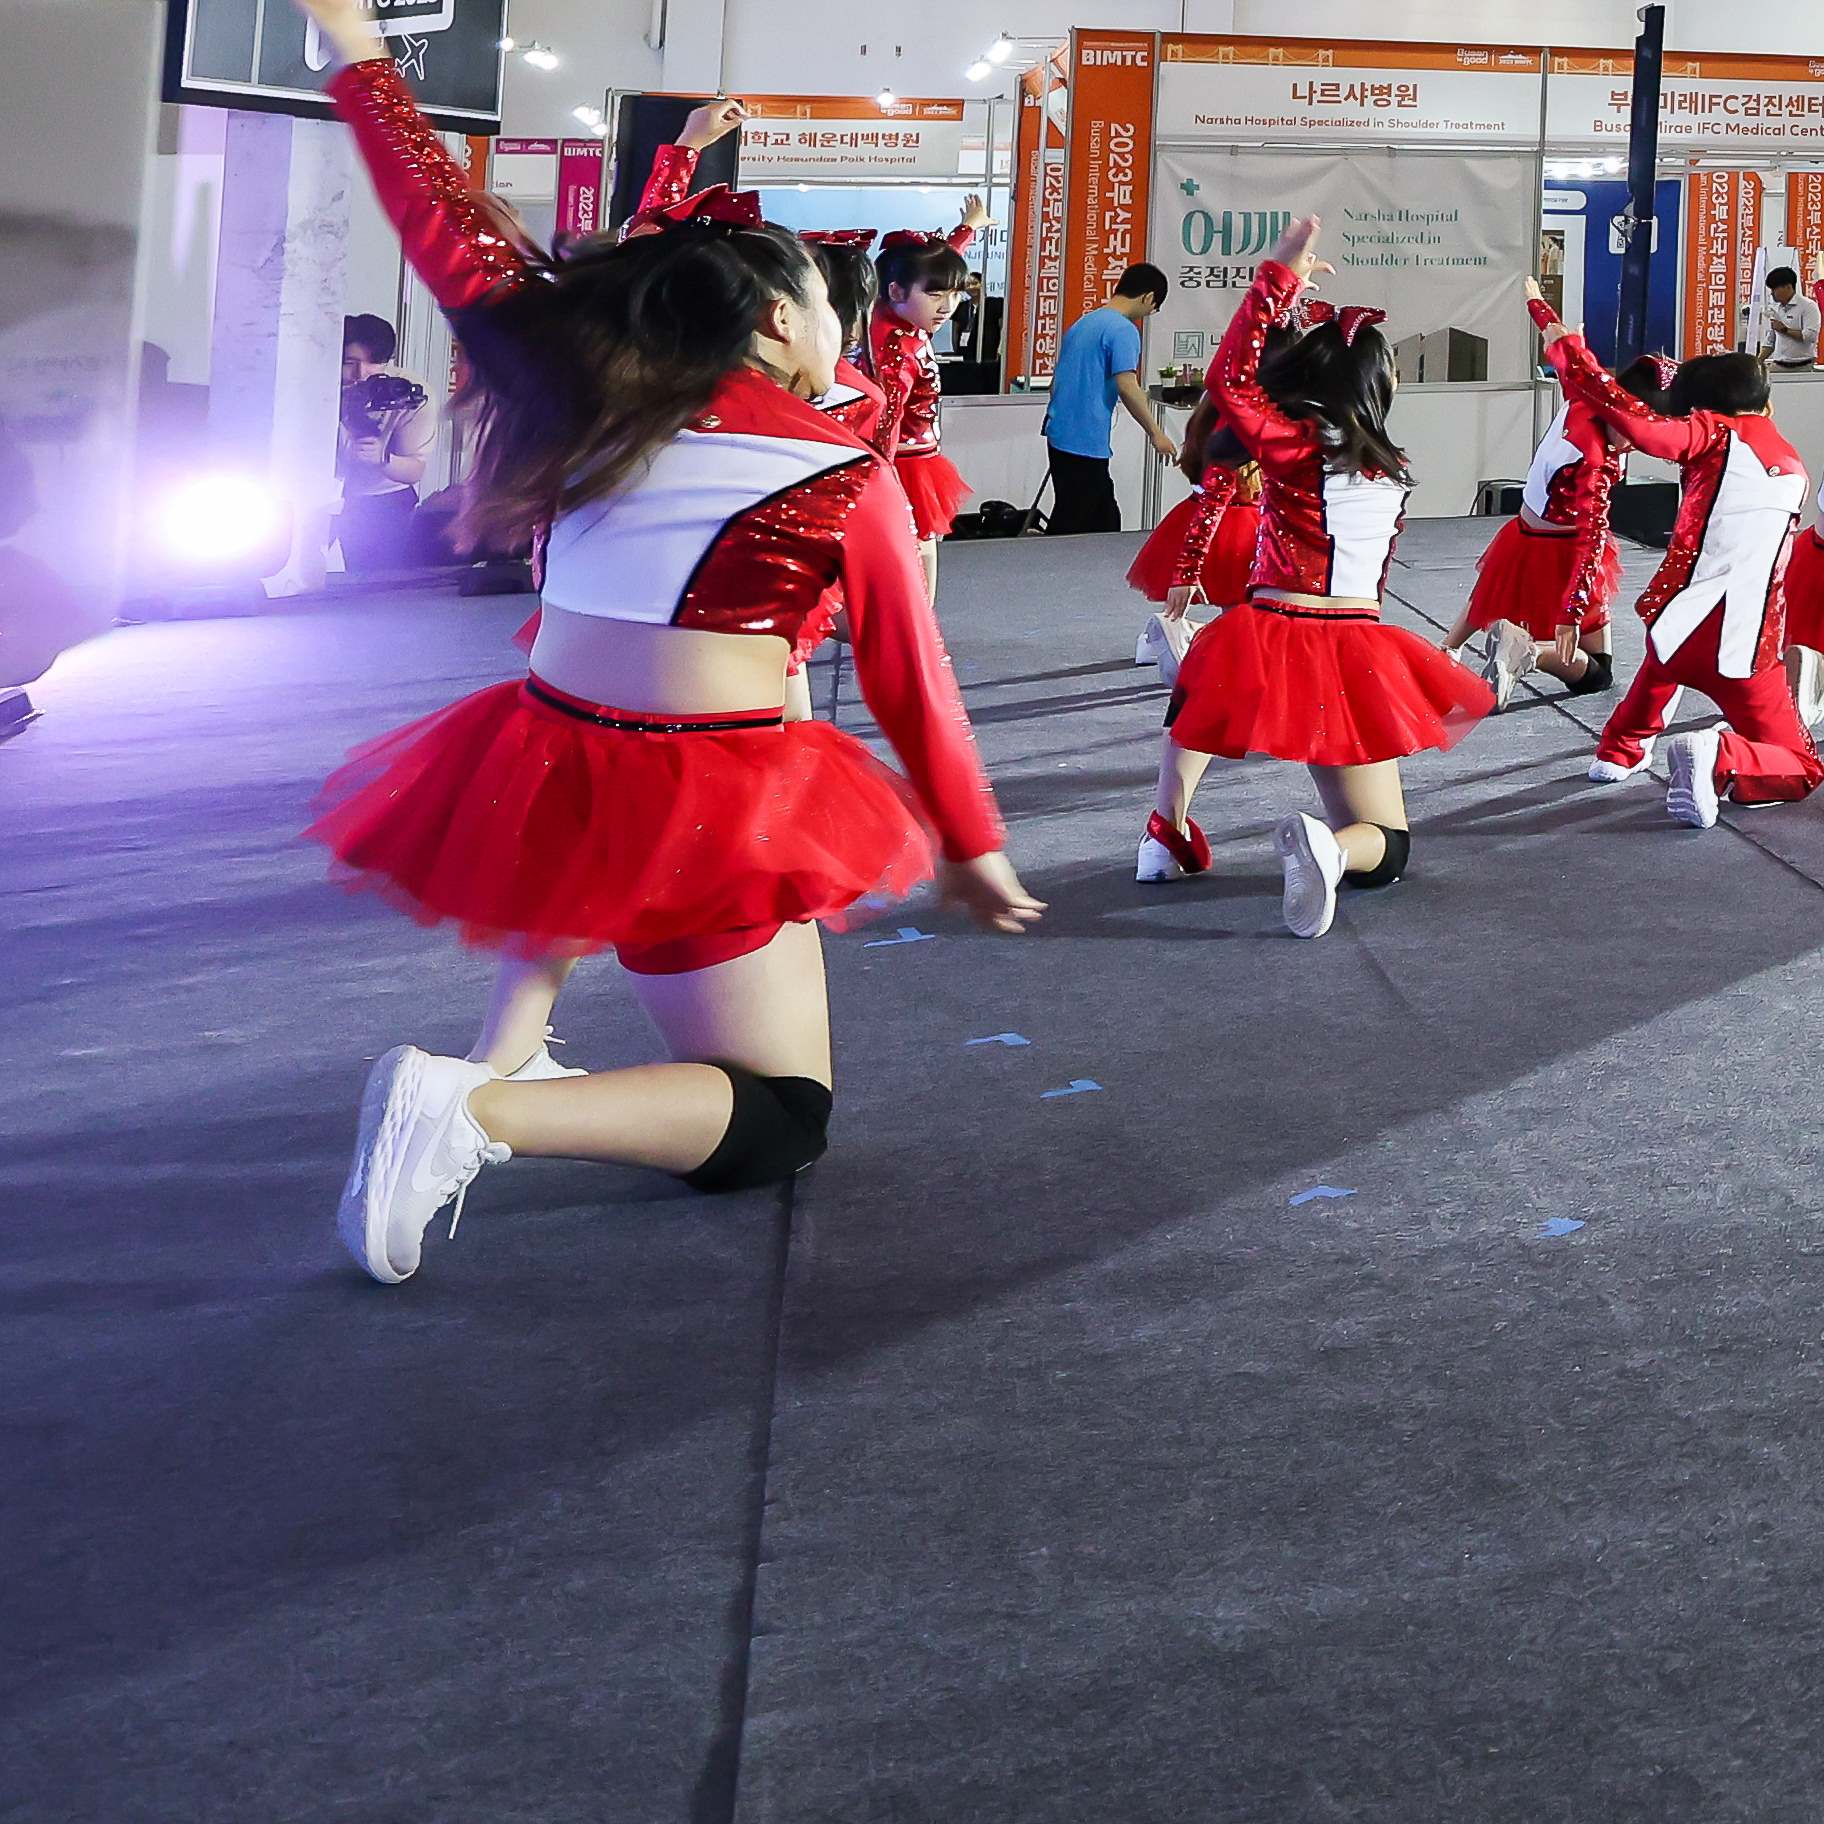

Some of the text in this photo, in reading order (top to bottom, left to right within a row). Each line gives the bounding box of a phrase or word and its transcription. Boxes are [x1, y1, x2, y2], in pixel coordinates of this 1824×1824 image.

[1081, 49, 1149, 67] BIMTC
[1291, 81, 1418, 108] 나르샤병원
[1194, 114, 1506, 131] Narsha Hospital Specialized in Shoulder Treatment
[1593, 120, 1631, 133] Busa
[1697, 122, 1721, 135] IFC
[1725, 123, 1786, 136] Medical
[798, 132, 920, 149] 해운대백병원
[1090, 120, 1104, 159] Busan
[840, 155, 866, 164] Paik
[868, 155, 916, 165] Hospital
[1084, 159, 1102, 240] International
[1101, 123, 1134, 309] 2023부산국제
[1344, 208, 1459, 225] Narsha Hospital
[1342, 231, 1441, 247] Specialized in
[1082, 242, 1098, 294] Medical
[1342, 253, 1488, 267] Shoulder Treatment
